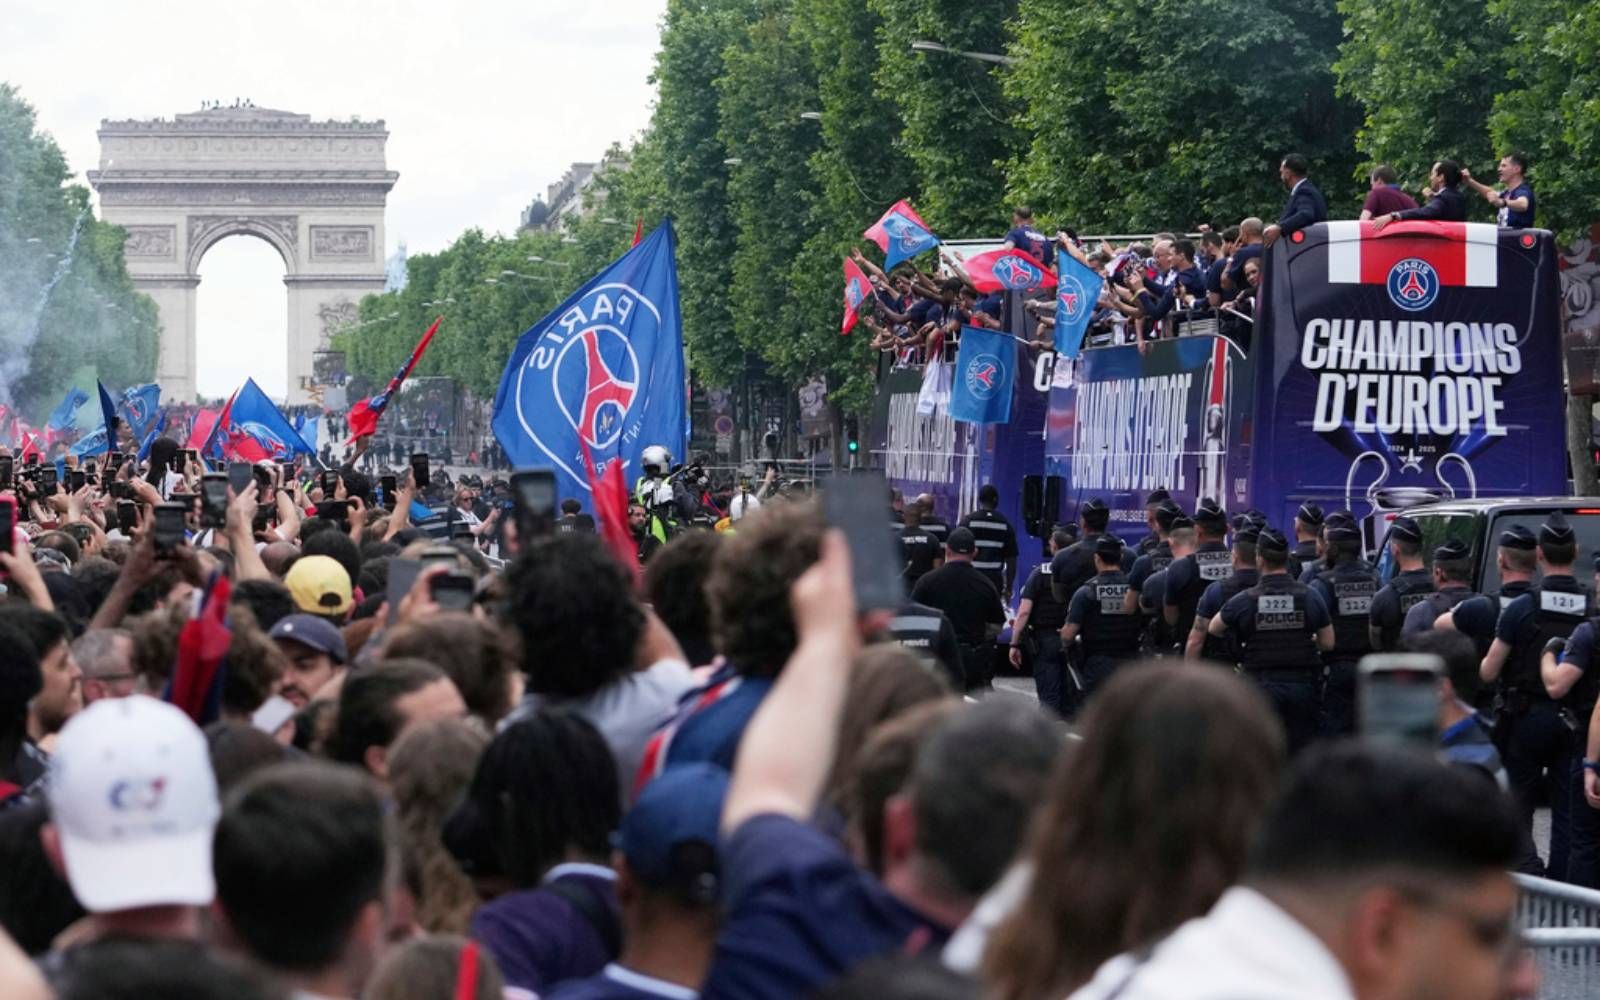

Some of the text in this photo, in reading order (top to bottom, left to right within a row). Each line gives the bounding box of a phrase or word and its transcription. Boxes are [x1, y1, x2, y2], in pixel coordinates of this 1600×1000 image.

[1396, 261, 1429, 274] PARIS
[1300, 317, 1522, 374] CHAMPIONS
[1312, 372, 1508, 436] D'EUROPE
[1335, 583, 1375, 594] POLICE
[1256, 612, 1304, 624] POLICE
